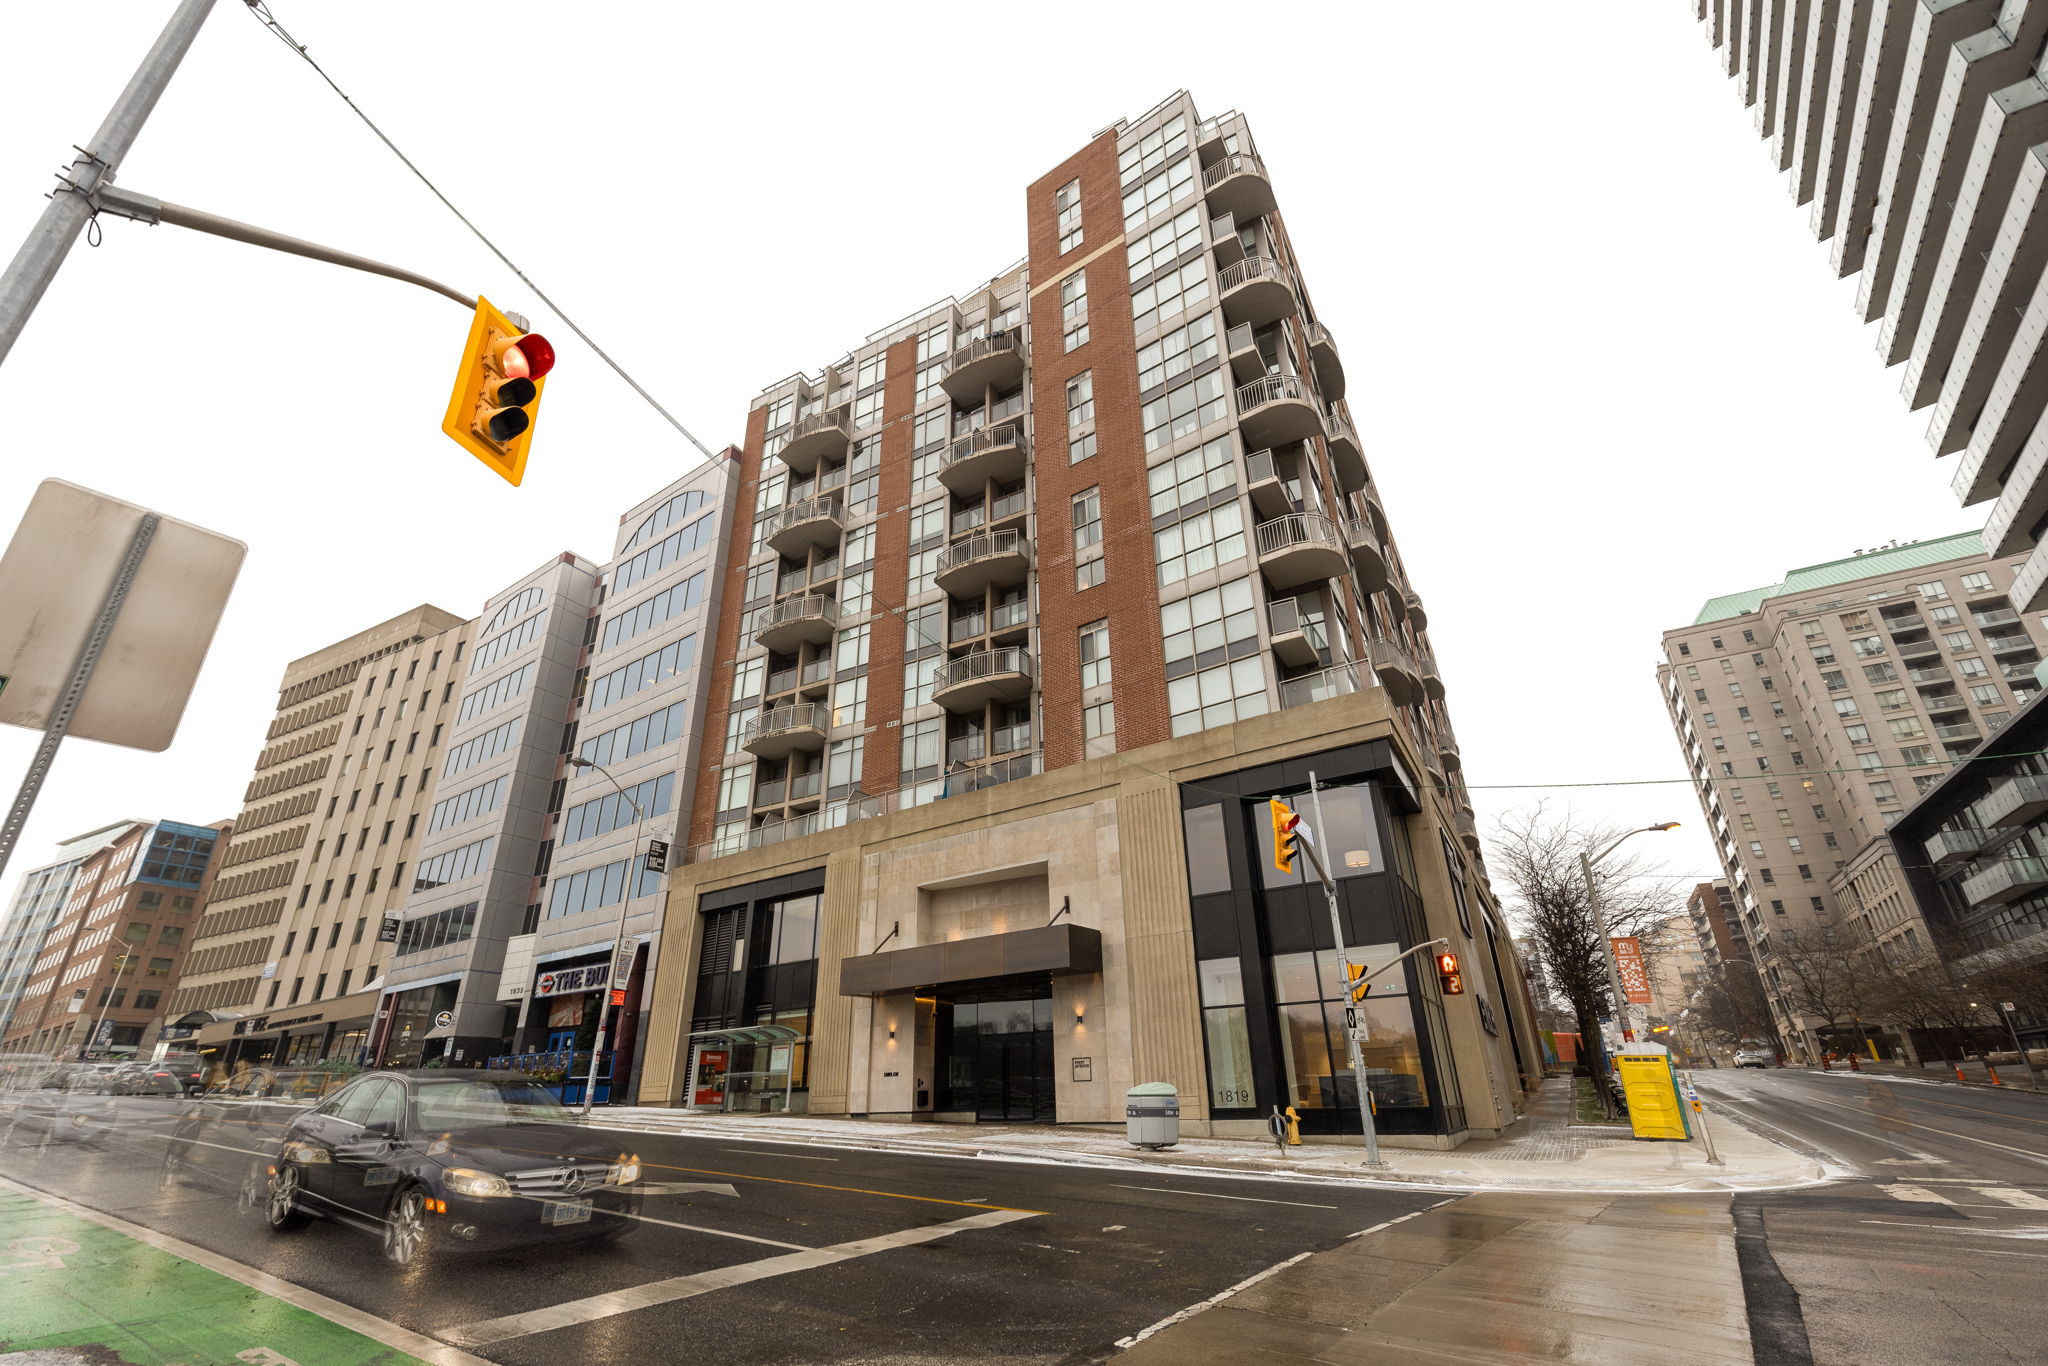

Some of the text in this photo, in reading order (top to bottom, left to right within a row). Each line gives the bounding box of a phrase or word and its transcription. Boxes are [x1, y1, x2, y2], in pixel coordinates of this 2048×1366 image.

[555, 969, 584, 992] THE
[510, 987, 524, 995] 1835
[1218, 1090, 1249, 1103] 1819
